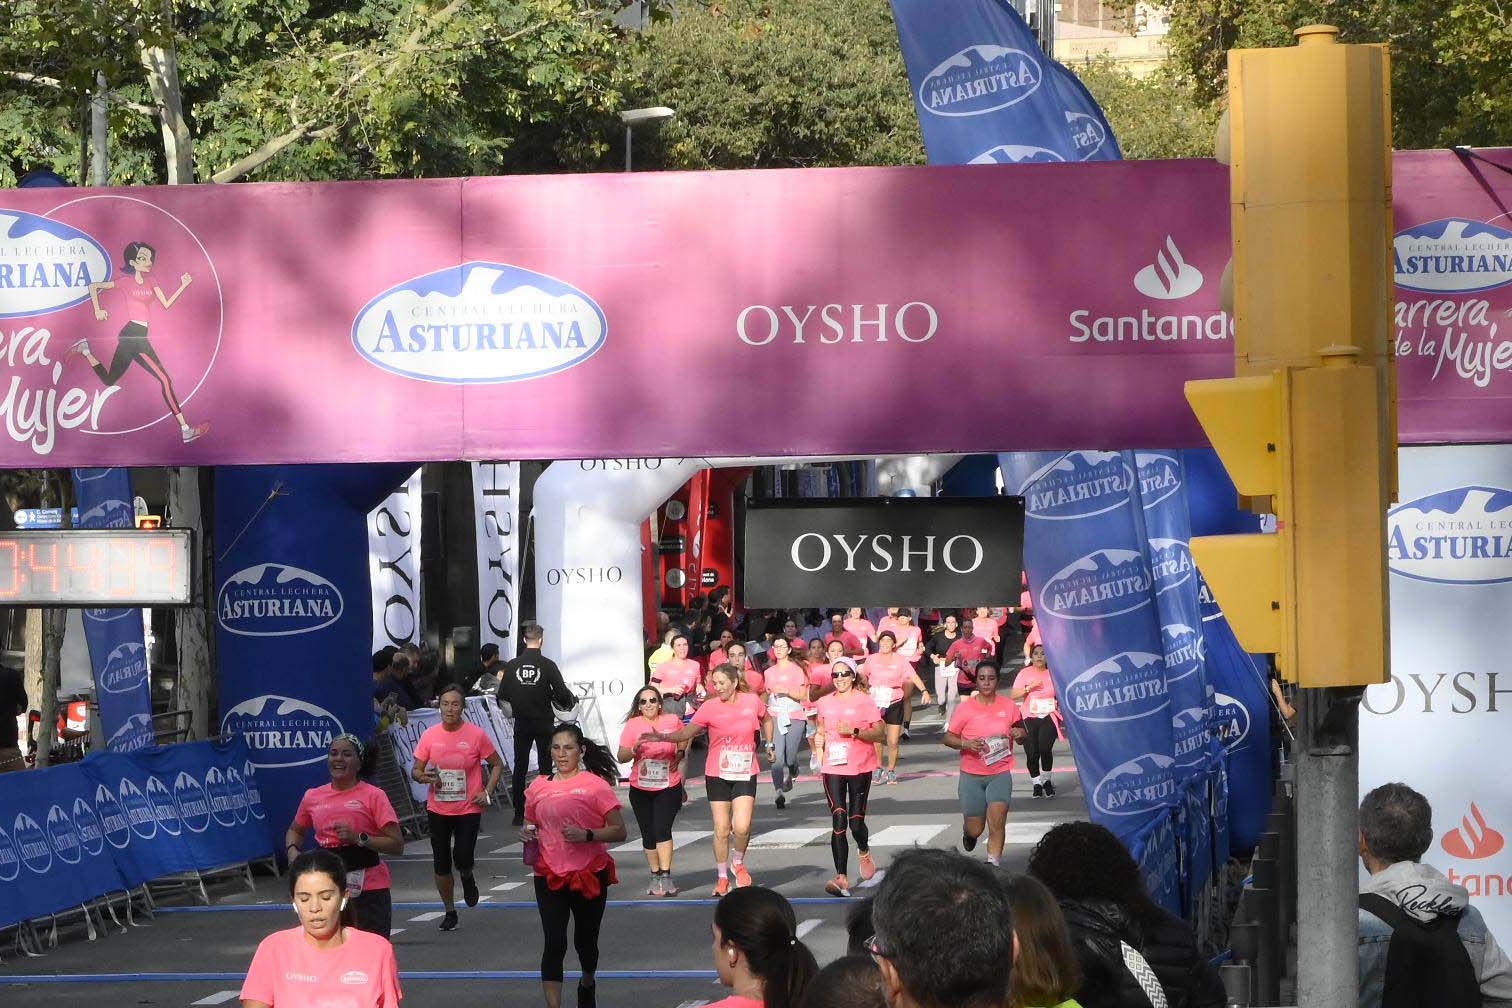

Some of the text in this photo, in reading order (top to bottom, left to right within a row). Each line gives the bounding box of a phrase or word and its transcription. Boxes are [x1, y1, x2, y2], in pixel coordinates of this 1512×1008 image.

[13, 244, 86, 257] LECHERA
[1409, 242, 1512, 252] CENTRAL LECHER
[1393, 247, 1512, 273] ASTURIAN
[410, 304, 489, 319] CENTRAL
[736, 301, 938, 346] OYSHO
[1395, 299, 1489, 327] arrera
[372, 309, 587, 353] ASTURIANA
[1419, 322, 1512, 388] la Muje
[1416, 520, 1482, 531] CENTRAL
[480, 461, 513, 639] OYSH
[791, 532, 984, 574] OYSHO
[546, 566, 622, 586] OYSHO
[281, 588, 329, 596] LECHERA
[222, 593, 334, 620] ASTURIANA
[522, 669, 535, 678] BP
[1361, 671, 1512, 715] OYSH
[226, 724, 333, 749] TURIANA
[236, 720, 330, 728] CENTRAL LECHERA
